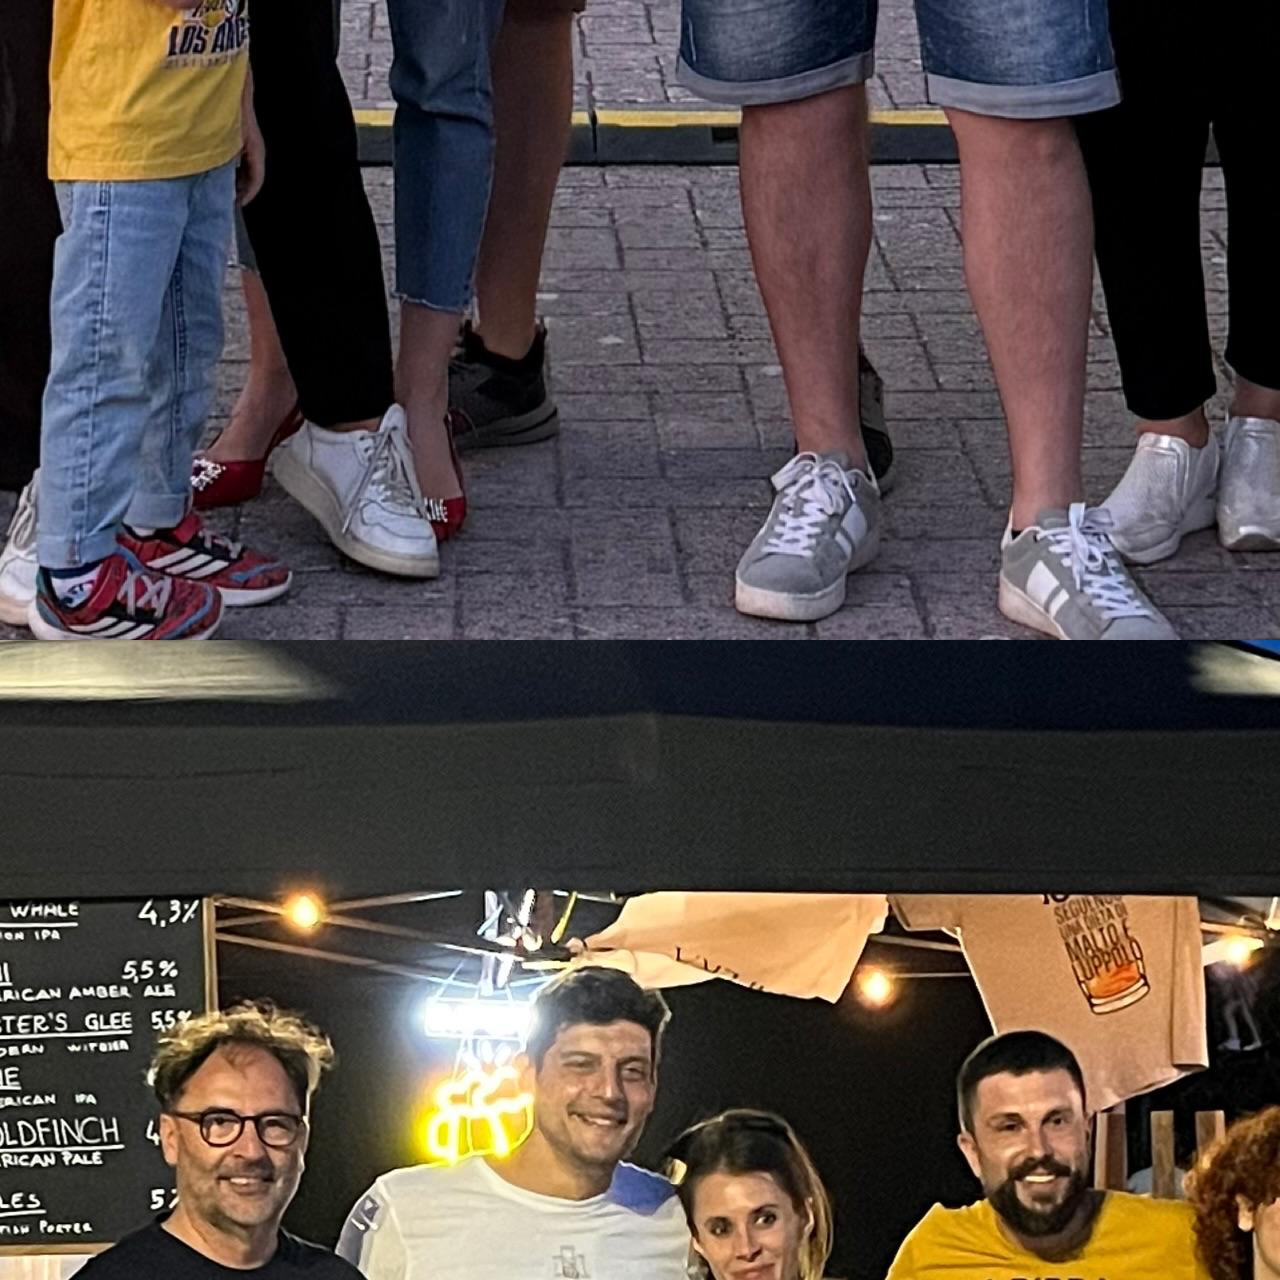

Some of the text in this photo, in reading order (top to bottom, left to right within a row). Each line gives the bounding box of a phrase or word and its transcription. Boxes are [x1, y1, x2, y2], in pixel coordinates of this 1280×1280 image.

[143, 983, 176, 998] ALE
[84, 1011, 133, 1032] GLEE
[62, 1150, 103, 1167] PALE
